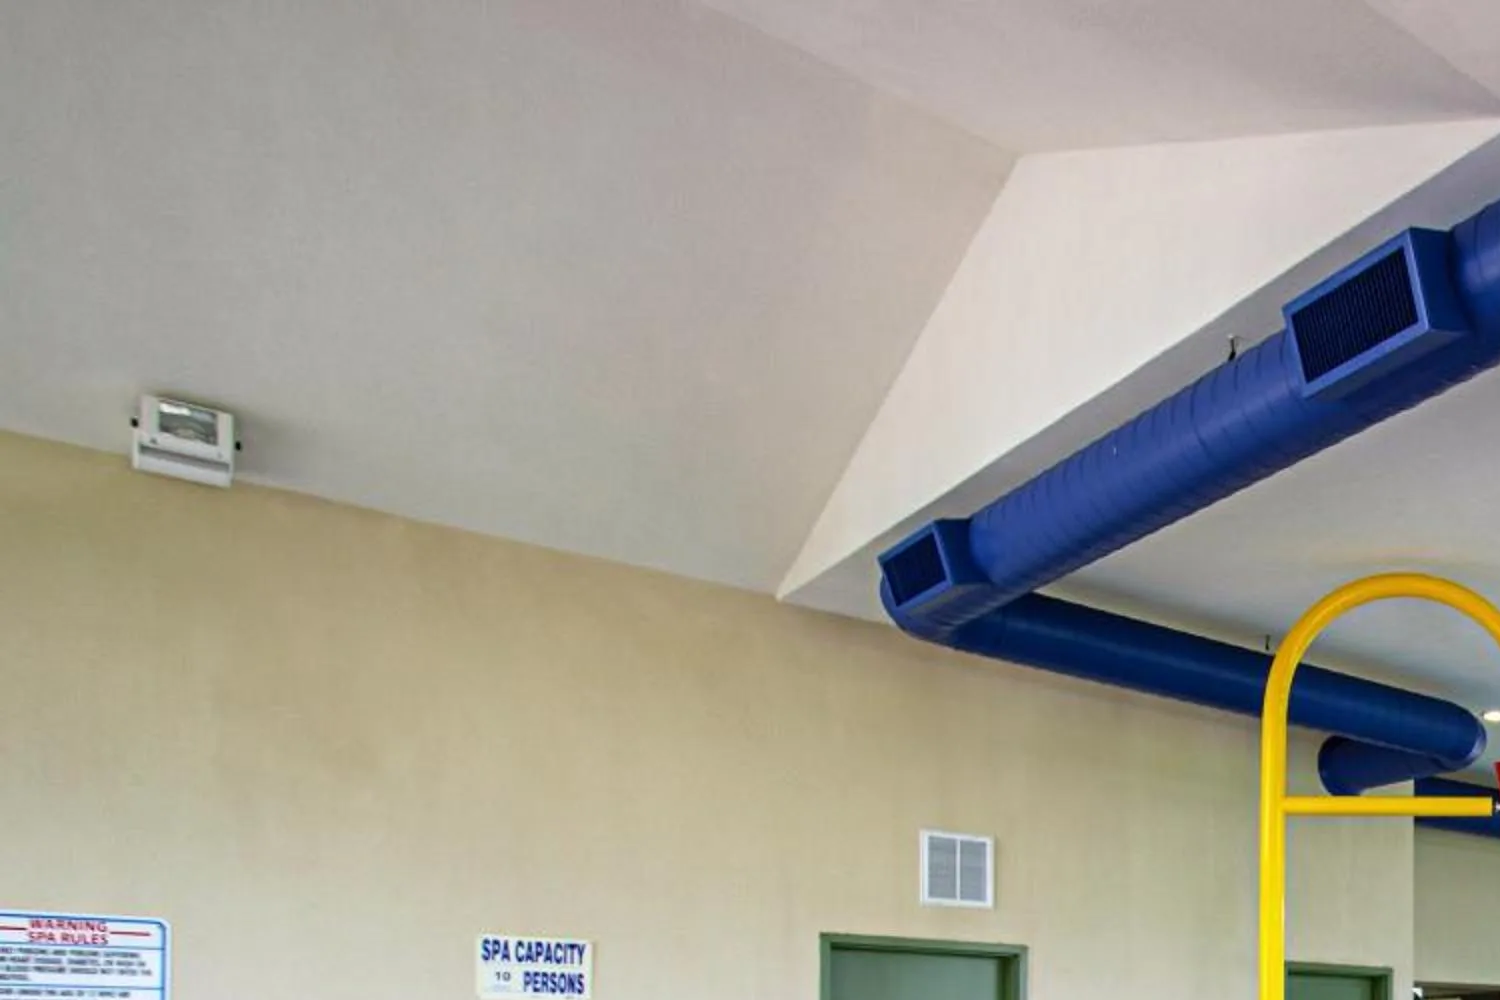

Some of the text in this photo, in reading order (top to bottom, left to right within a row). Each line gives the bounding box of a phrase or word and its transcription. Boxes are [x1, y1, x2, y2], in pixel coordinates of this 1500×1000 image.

[29, 919, 108, 933] WARNING
[28, 931, 109, 945] SPA RULES
[481, 938, 586, 965] SPA CAPACITY
[494, 971, 584, 995] 10 PERSONS
